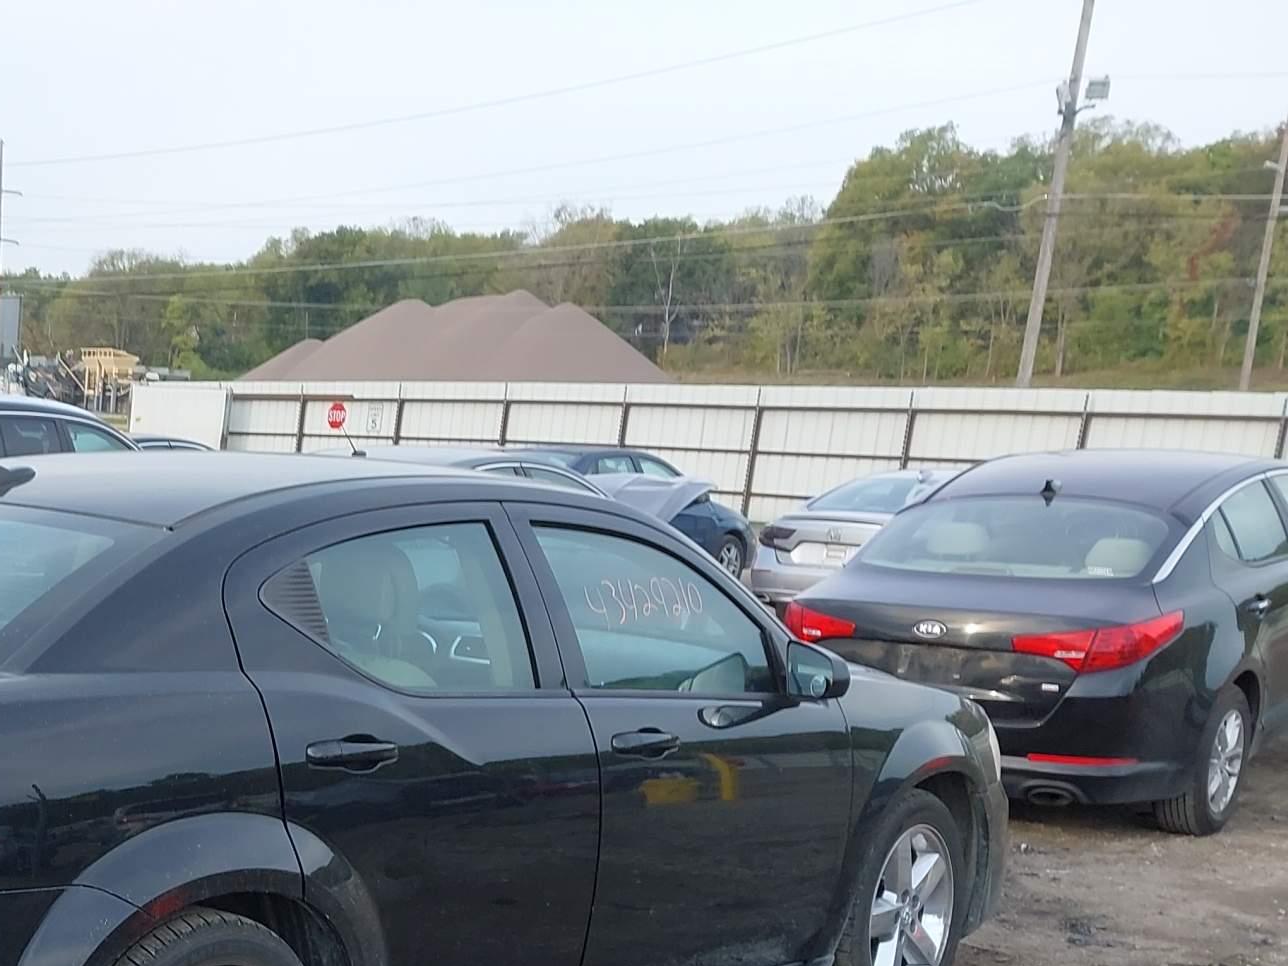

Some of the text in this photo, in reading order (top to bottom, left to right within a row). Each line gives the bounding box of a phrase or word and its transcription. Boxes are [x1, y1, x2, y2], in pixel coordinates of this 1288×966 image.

[328, 409, 346, 423] STOP
[584, 577, 703, 631] 43429210
[919, 623, 941, 635] KIA
